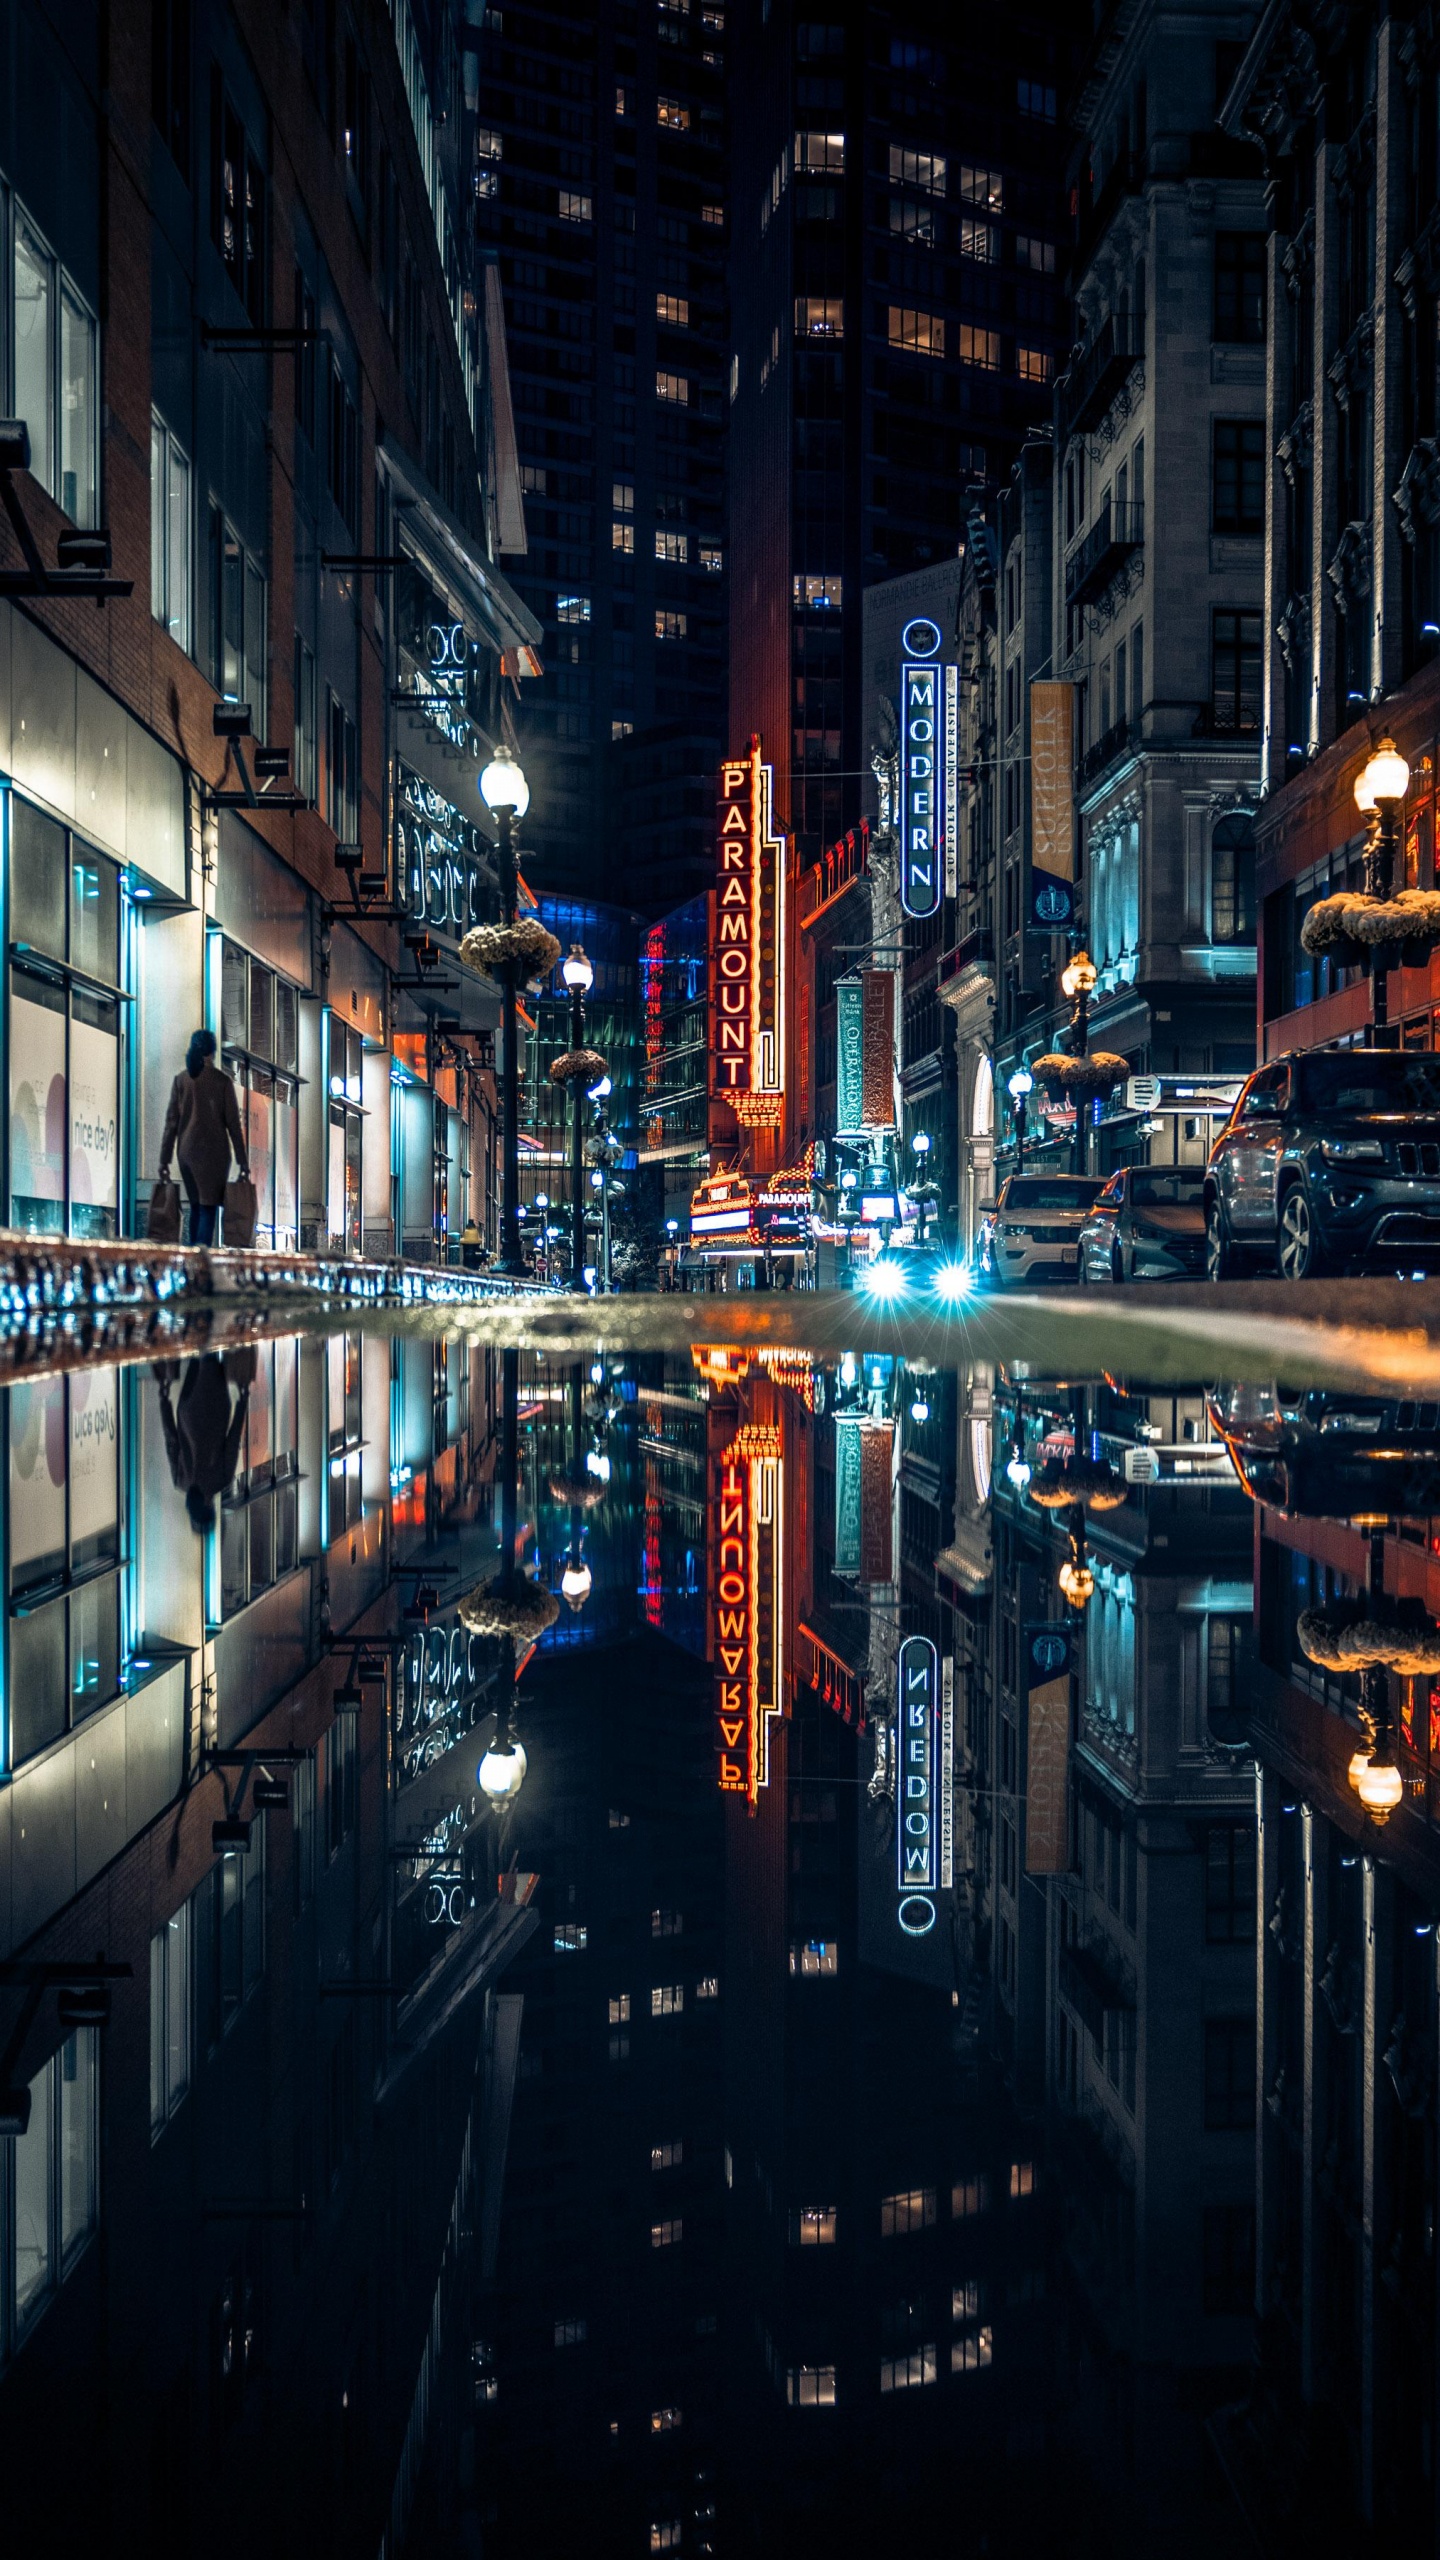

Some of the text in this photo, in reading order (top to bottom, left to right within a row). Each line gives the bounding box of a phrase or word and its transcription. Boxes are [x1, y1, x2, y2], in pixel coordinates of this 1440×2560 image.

[910, 683, 934, 887] MODERN
[947, 692, 956, 876] SUFFOLK UNIVERSITY
[1034, 706, 1056, 855] SUFFOLK
[720, 769, 749, 1086] PARAMOUNT
[74, 1112, 115, 1161] nice day?
[758, 1193, 811, 1204] PARAMOUNT
[1030, 1154, 1048, 1163] WEST
